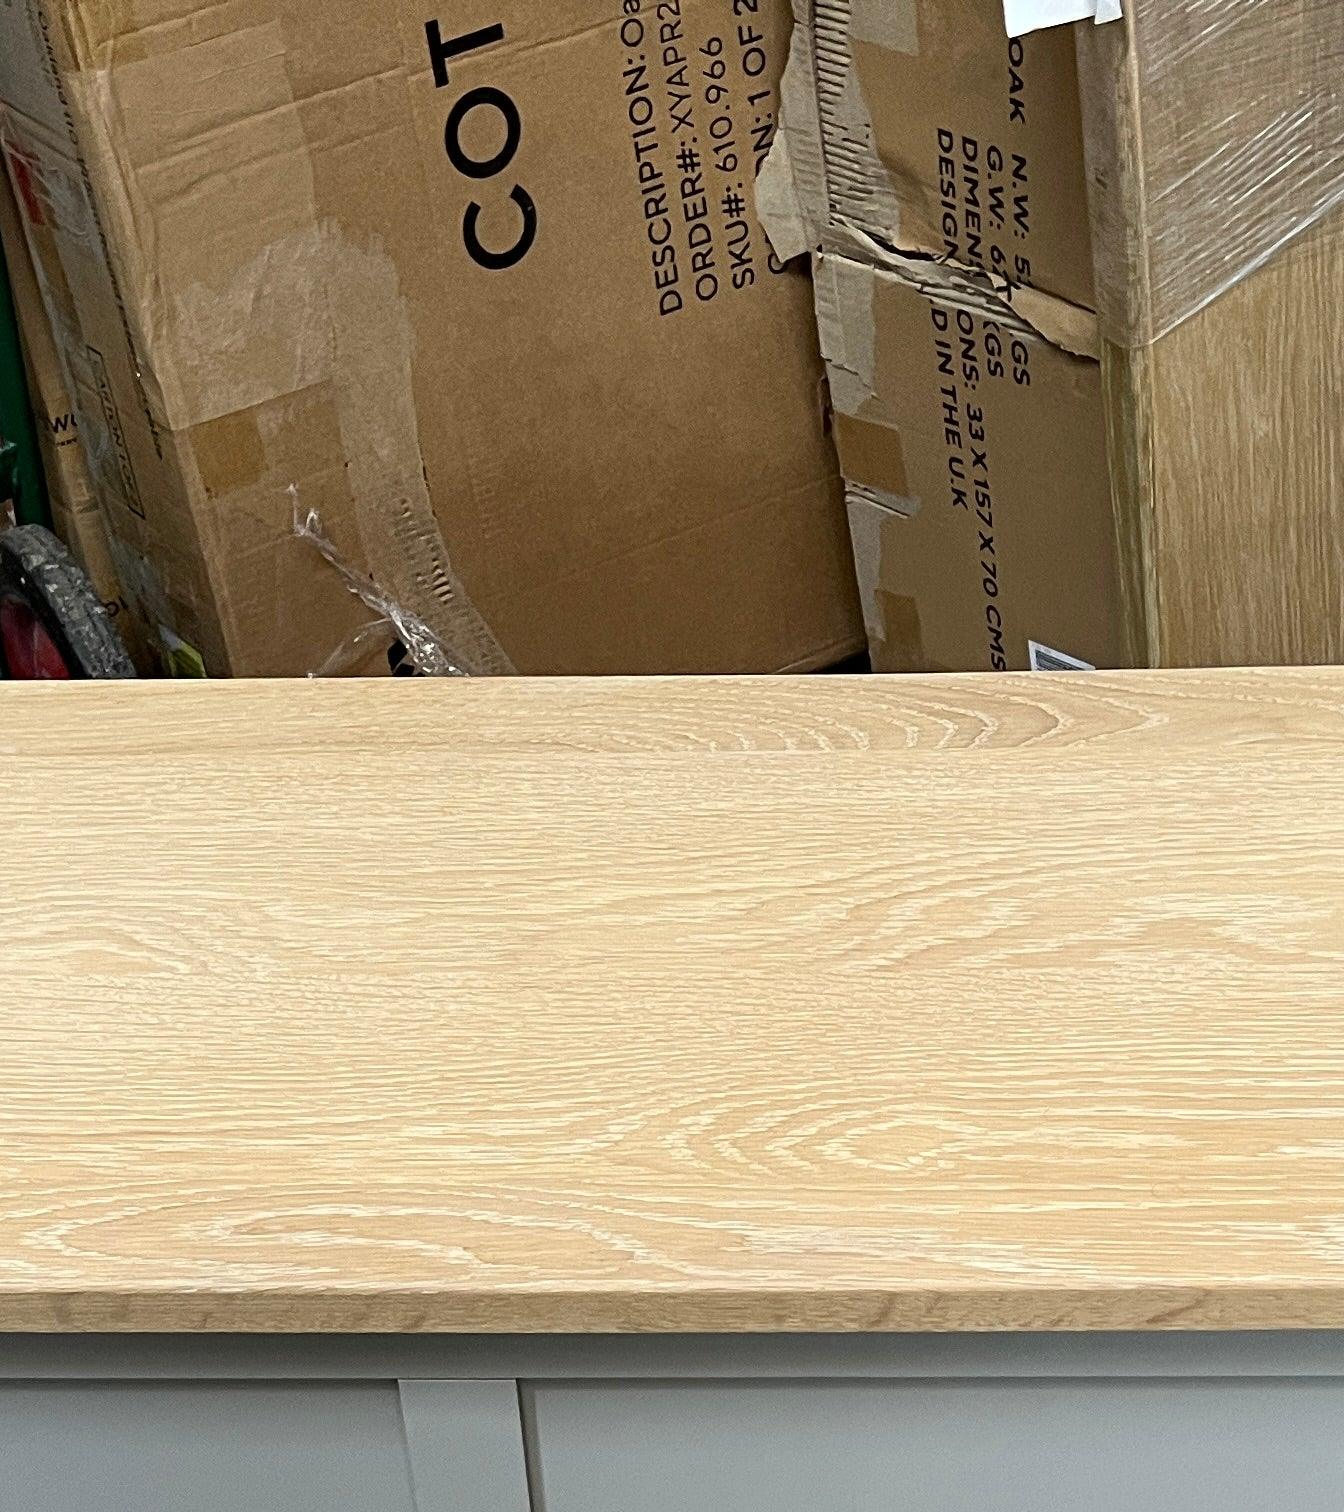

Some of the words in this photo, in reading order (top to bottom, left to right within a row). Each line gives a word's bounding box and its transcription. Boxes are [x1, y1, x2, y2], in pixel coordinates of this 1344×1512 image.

[738, 25, 766, 77] OF
[699, 37, 738, 172] 610.966
[747, 90, 771, 106] 1
[1008, 37, 1026, 126] OAK
[424, 19, 538, 271] COT
[986, 144, 1005, 230] G.W:
[1011, 153, 1030, 240] N.W:
[721, 182, 755, 289] SKU#:
[935, 339, 955, 376] IN
[941, 385, 962, 449] THE
[966, 402, 985, 442] 33
[948, 456, 968, 511] U.K
[970, 446, 988, 473] X
[973, 478, 993, 528] 157
[978, 530, 995, 556] X
[981, 560, 999, 598] 70
[986, 604, 1006, 671] CMS
